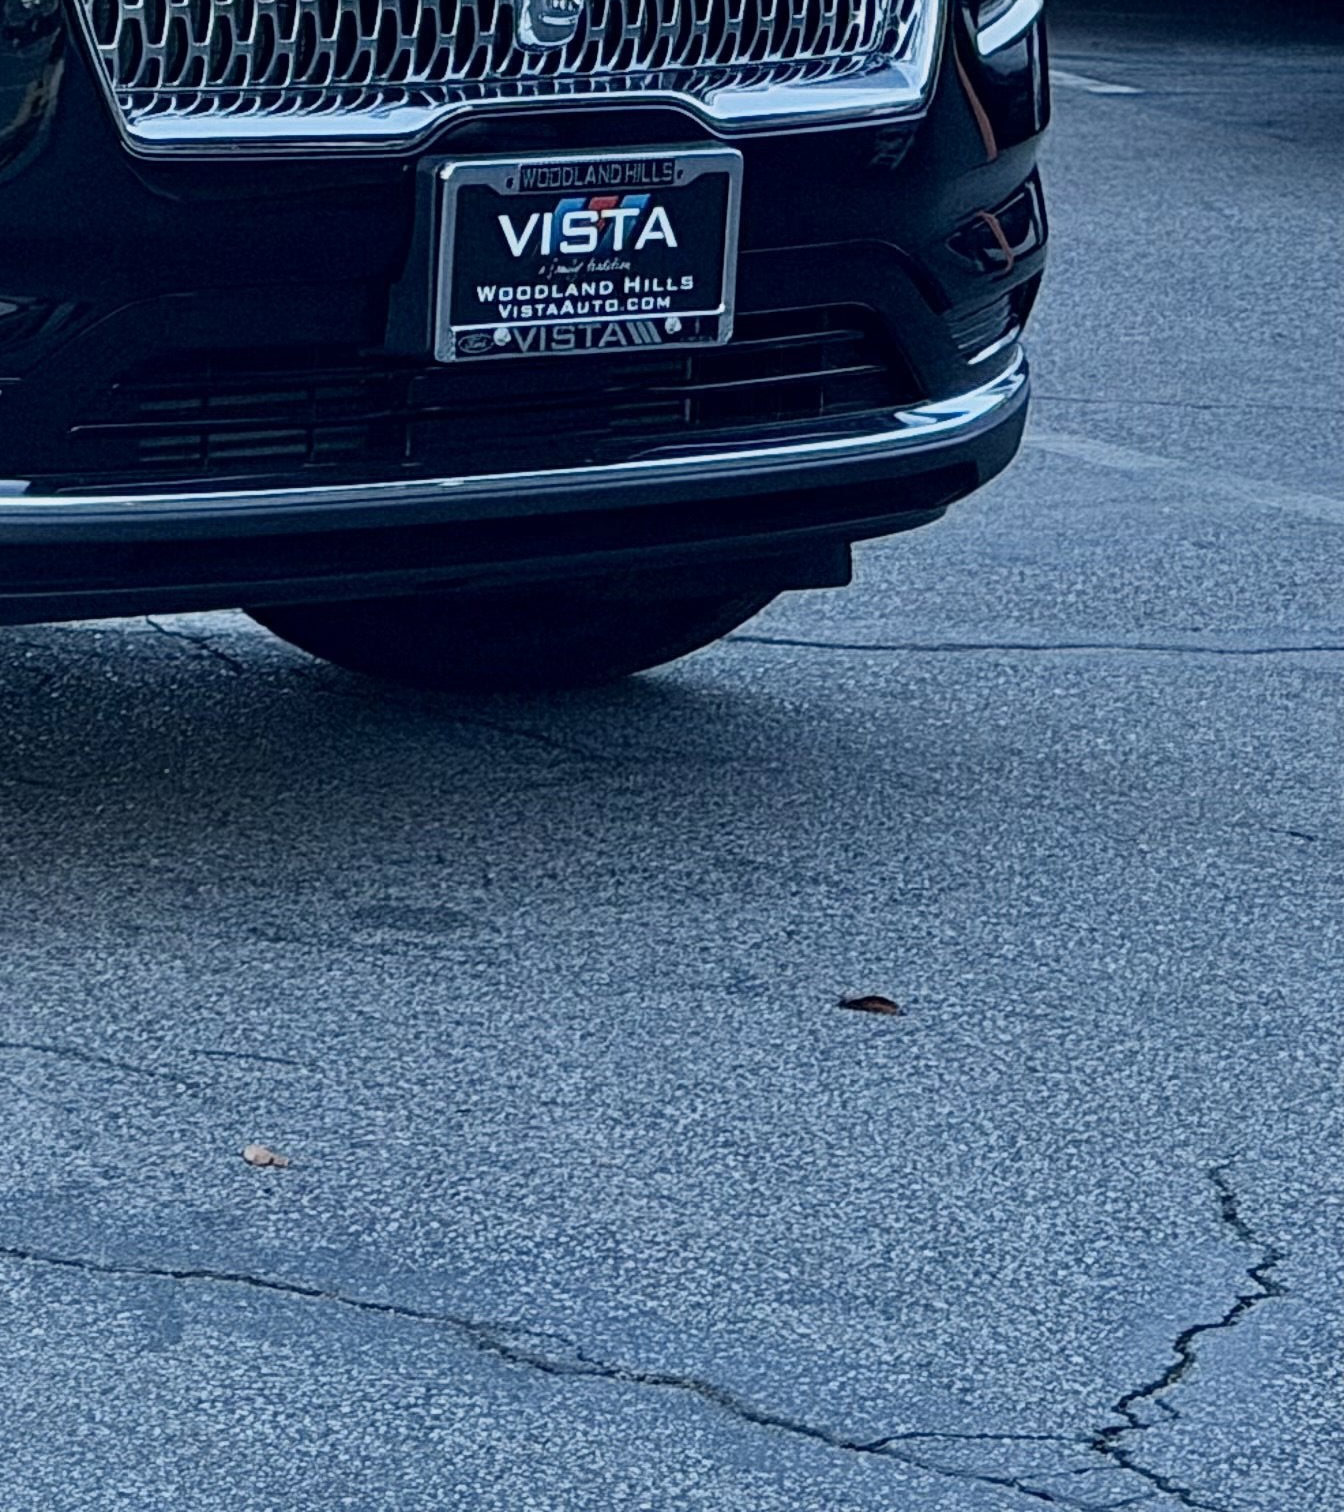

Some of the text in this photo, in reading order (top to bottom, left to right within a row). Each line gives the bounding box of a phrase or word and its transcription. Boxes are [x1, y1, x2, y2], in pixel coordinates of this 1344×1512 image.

[521, 161, 674, 188] WOODLAND HILLS
[497, 206, 678, 257] VISTA
[513, 322, 627, 352] VISTA
